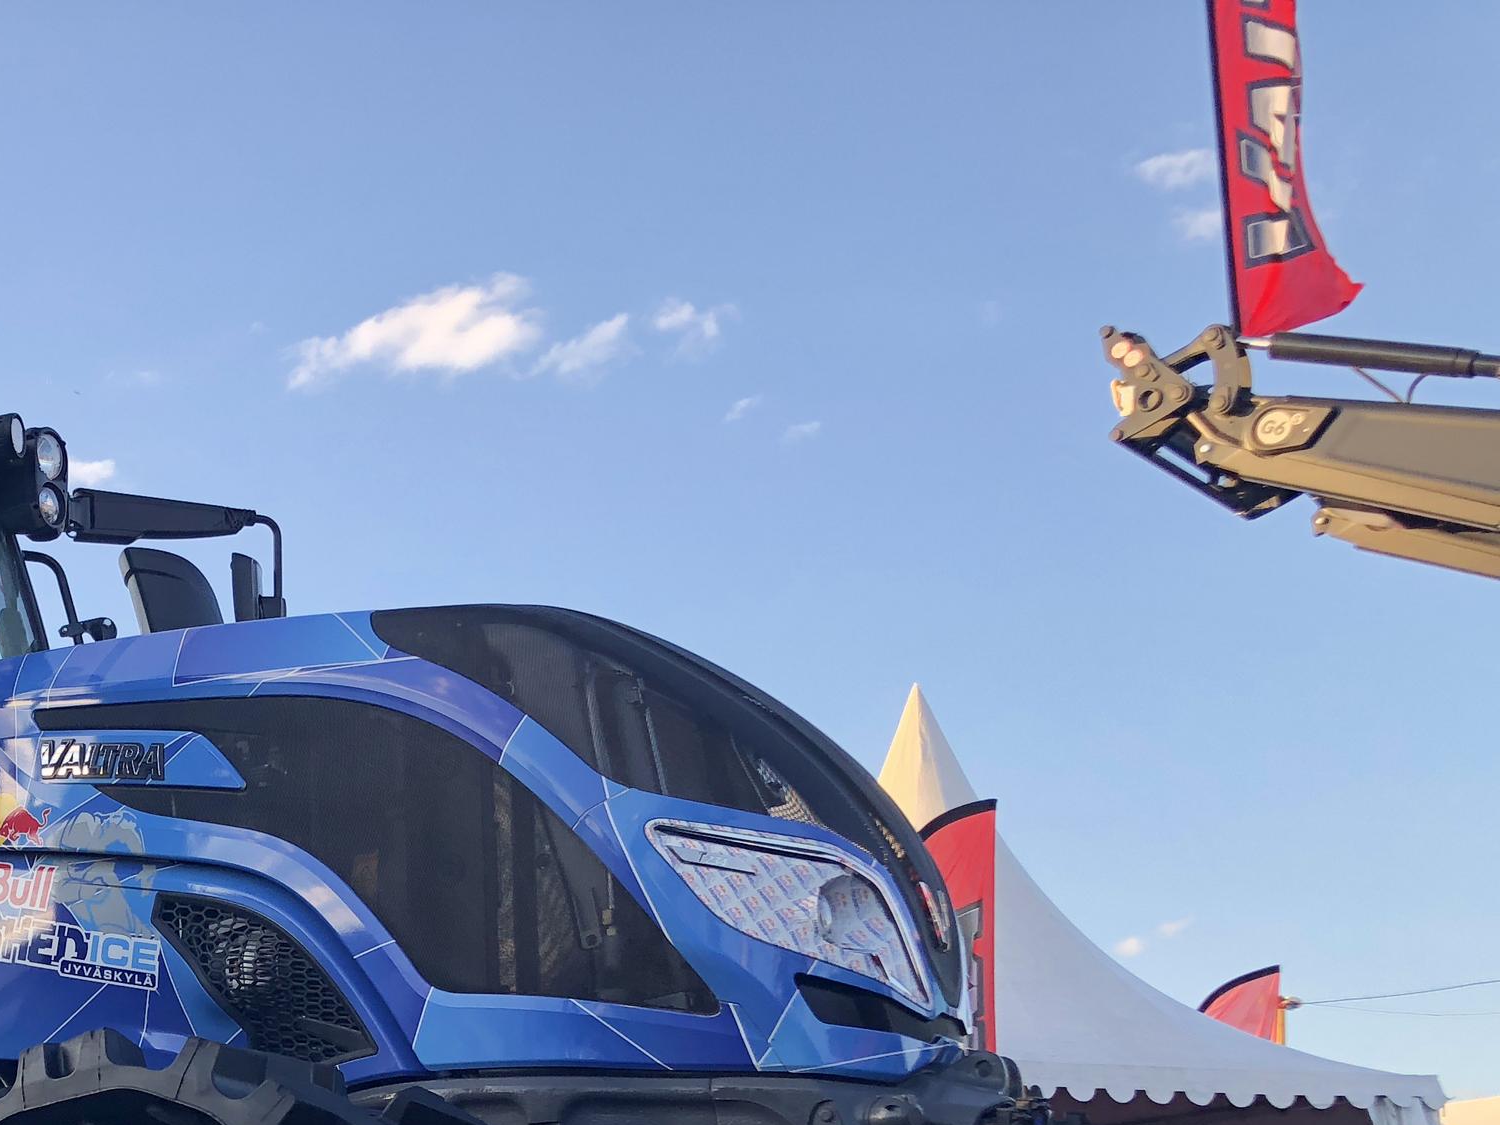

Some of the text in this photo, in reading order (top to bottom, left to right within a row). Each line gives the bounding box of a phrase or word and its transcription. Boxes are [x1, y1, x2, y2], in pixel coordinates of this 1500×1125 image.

[40, 738, 165, 781] VALTRA
[90, 933, 158, 971] ICE
[62, 960, 156, 989] JYVÄSKYLÄ
